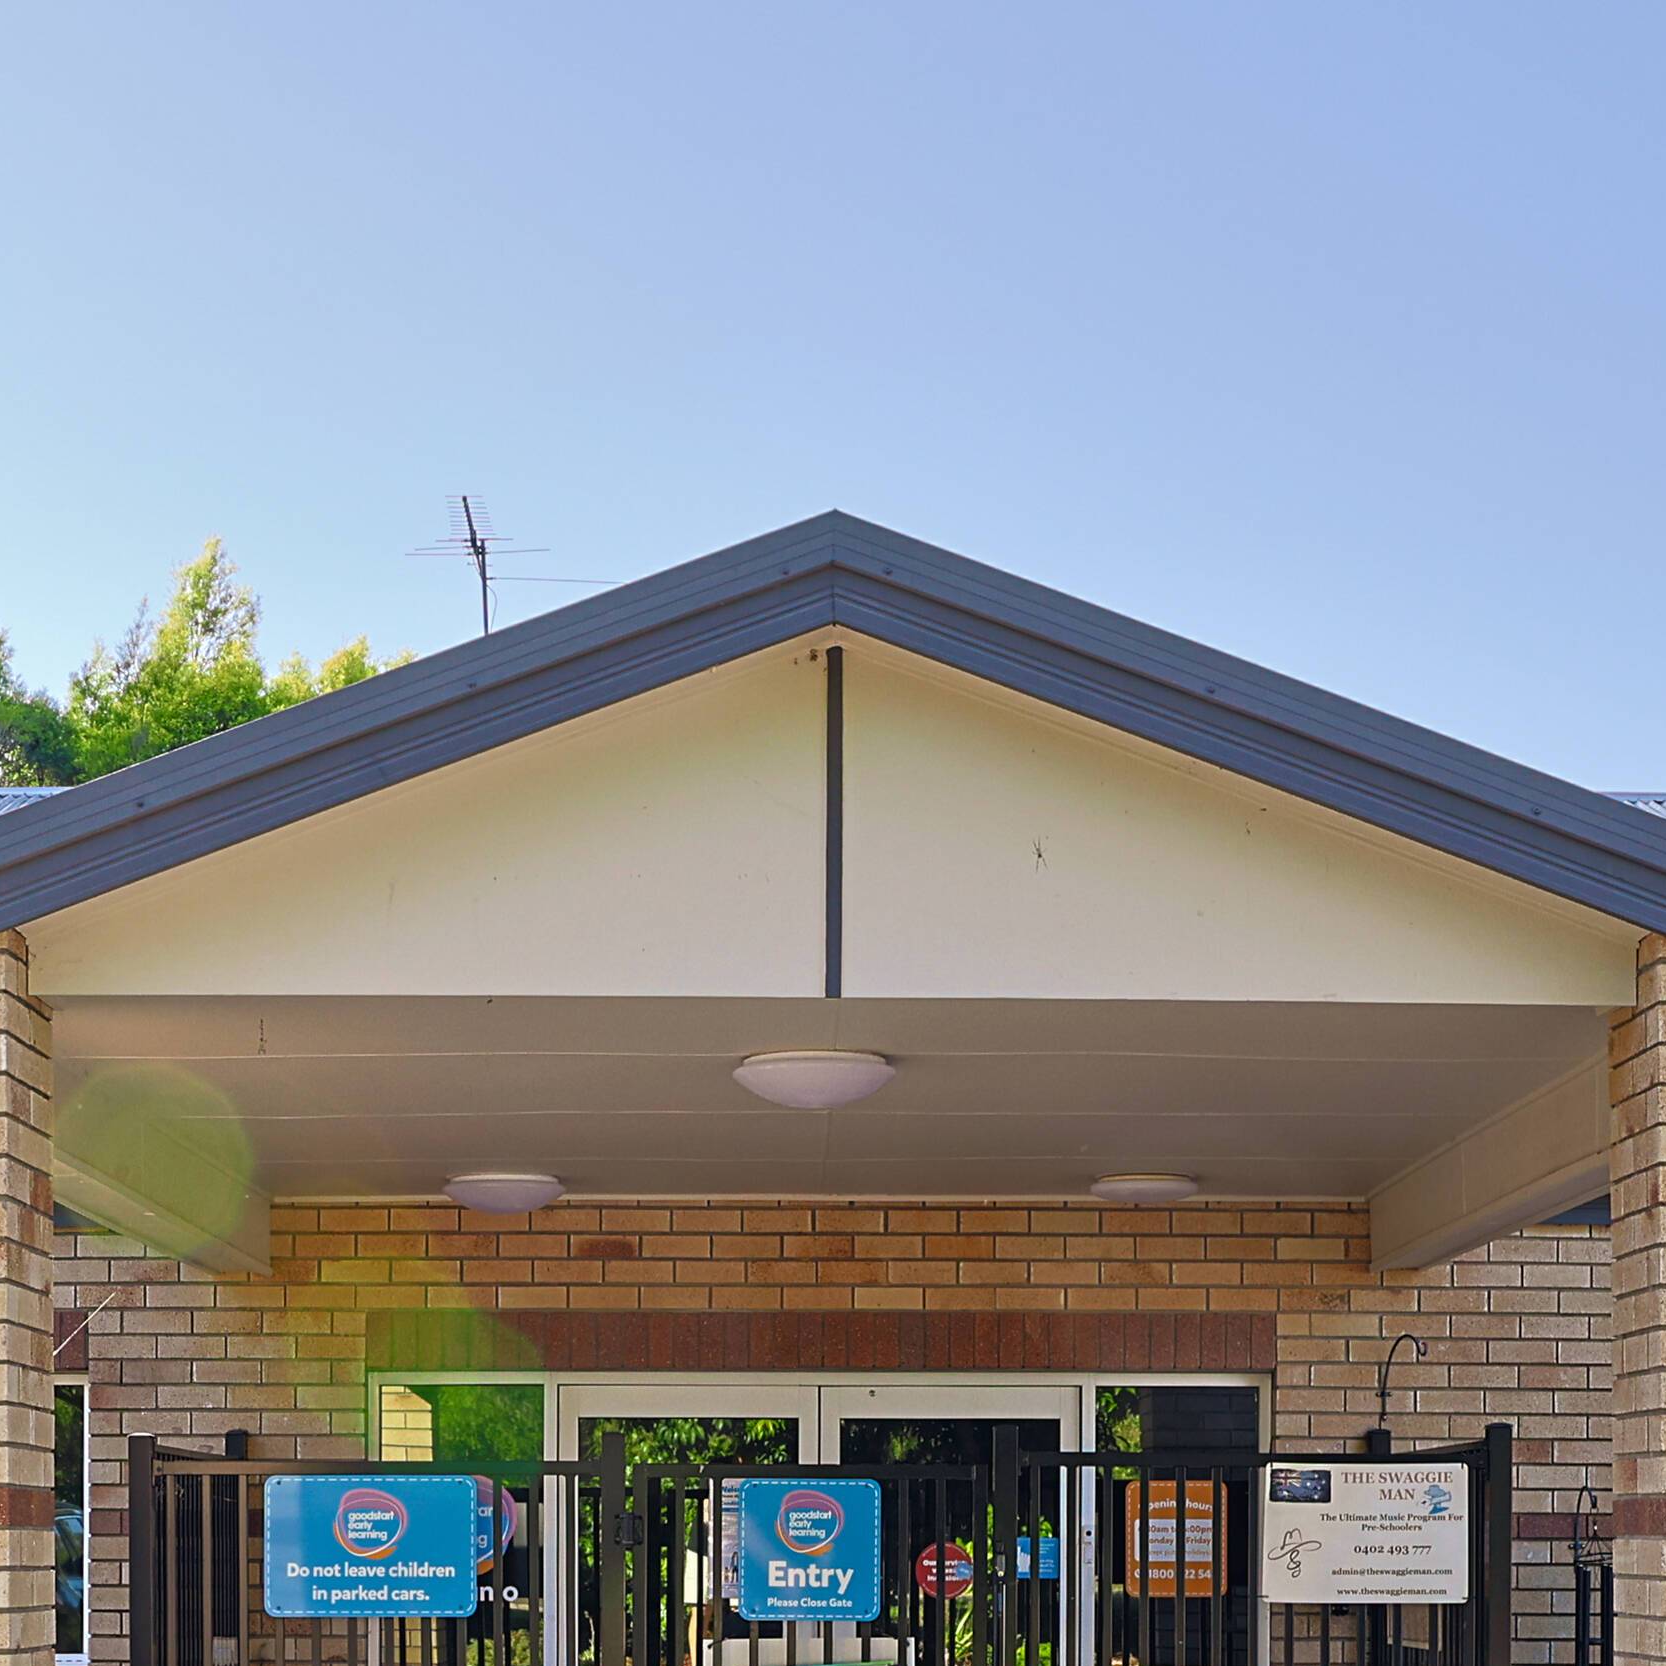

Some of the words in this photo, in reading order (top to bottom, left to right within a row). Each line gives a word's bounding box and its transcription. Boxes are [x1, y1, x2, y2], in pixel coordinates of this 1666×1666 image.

[1341, 1471, 1375, 1484] THE
[1378, 1471, 1453, 1484] SWAGGIE
[1379, 1489, 1416, 1501] MAN
[348, 1511, 395, 1522] goodstart
[789, 1510, 832, 1520] goodstart
[1320, 1513, 1337, 1521] The
[1339, 1513, 1378, 1521] Ultimate
[1379, 1513, 1406, 1521] Music
[1407, 1513, 1446, 1523] Program
[1448, 1513, 1464, 1521] For
[348, 1521, 373, 1531] early
[789, 1520, 812, 1529] early
[1361, 1523, 1423, 1532] Pre-Schoolers
[348, 1529, 388, 1541] learning
[789, 1528, 826, 1539] learning
[1185, 1536, 1212, 1546] Friday
[1354, 1545, 1385, 1555] 0402
[1387, 1545, 1410, 1556] 493
[1412, 1545, 1432, 1556] 777
[286, 1562, 310, 1578] Do
[312, 1564, 341, 1578] not
[344, 1562, 386, 1578] leave
[389, 1562, 455, 1578] children
[1331, 1567, 1453, 1577] admin@theswaggieman.com
[768, 1560, 854, 1595] Entry
[312, 1585, 327, 1601] in
[331, 1585, 388, 1604] parked
[391, 1588, 430, 1601] cars.
[1336, 1586, 1447, 1596] www.theswaggieman.com
[767, 1597, 799, 1607] Please
[800, 1597, 826, 1607] Close
[829, 1597, 853, 1607] Gate
